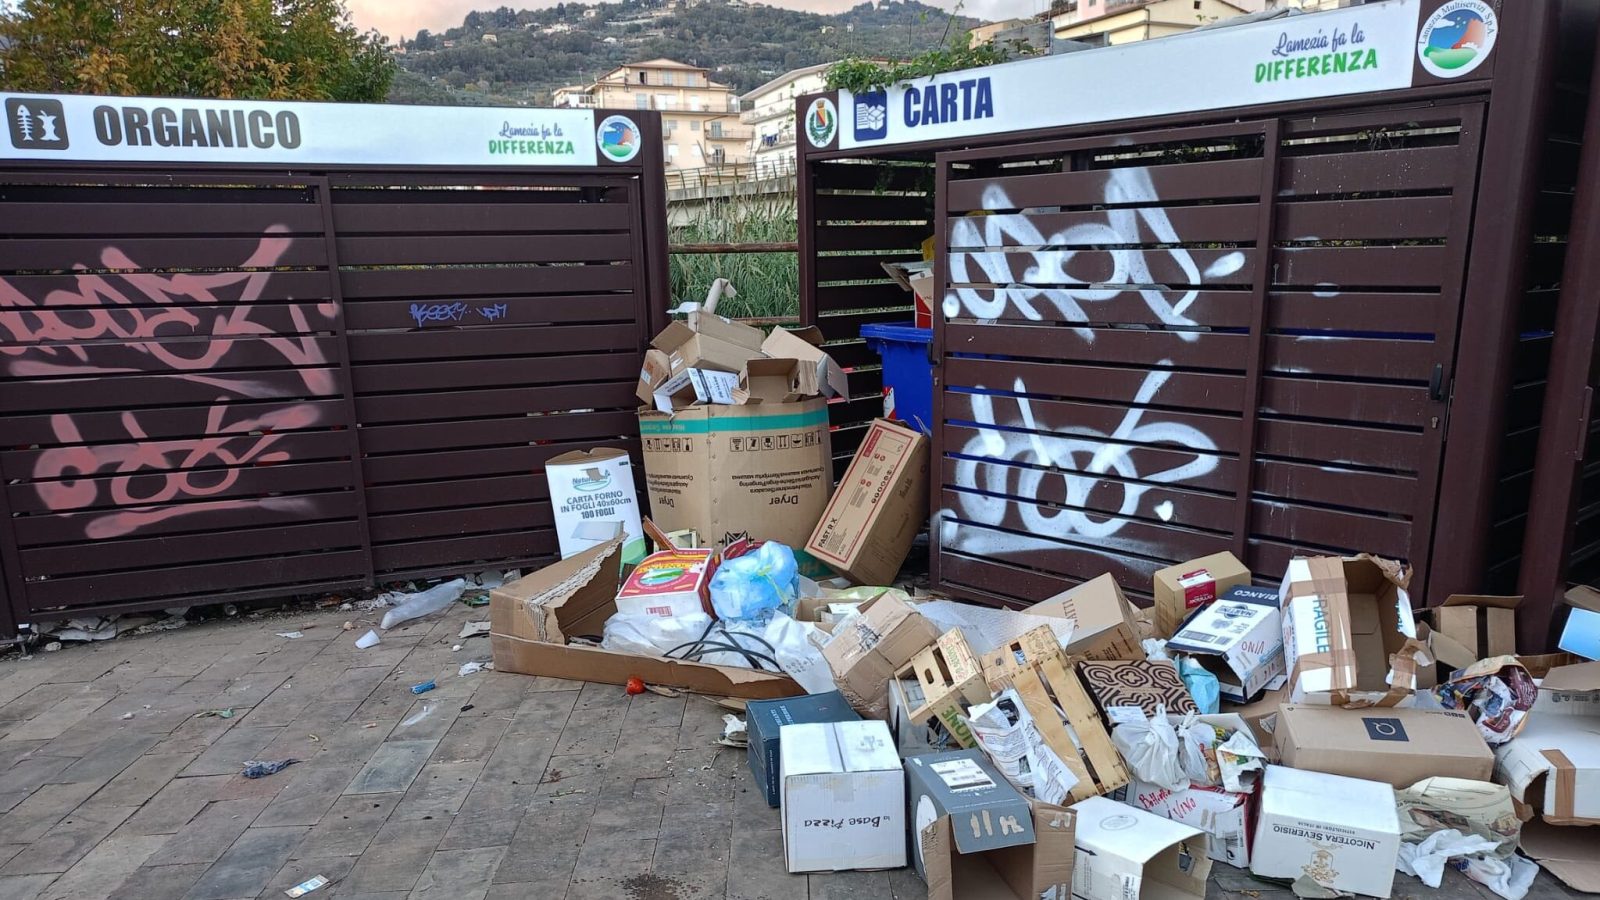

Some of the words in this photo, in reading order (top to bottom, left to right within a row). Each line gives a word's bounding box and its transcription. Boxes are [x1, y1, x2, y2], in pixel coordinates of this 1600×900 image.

[1271, 28, 1329, 57] Lamezia
[1331, 29, 1347, 55] fa
[1350, 22, 1366, 44] la
[1254, 48, 1378, 83] DIFFERENZA
[903, 77, 994, 127] CARTA
[93, 106, 302, 149] ORGANICO
[499, 120, 540, 139] Lamezia
[541, 123, 552, 141] fa
[553, 122, 564, 137] la
[488, 139, 575, 154] DIFFERENZA
[560, 504, 571, 513] IN
[571, 500, 597, 512] FOGLI
[596, 496, 632, 509] 40x60cm
[565, 494, 596, 506] CARTA
[597, 489, 624, 502] FORNO
[769, 494, 799, 506] Dryer
[580, 510, 599, 520] 100
[600, 507, 615, 518] FOGLI
[817, 529, 831, 548] FAST
[1234, 589, 1279, 601] BIANCO
[1312, 591, 1331, 654] FRAGILE
[1242, 641, 1264, 655] VINO
[1172, 797, 1197, 819] VINO
[804, 818, 844, 830] Pizza
[848, 816, 881, 828] Base
[1273, 825, 1323, 841] SEVERISIO
[1326, 834, 1375, 850] NICOTERA
